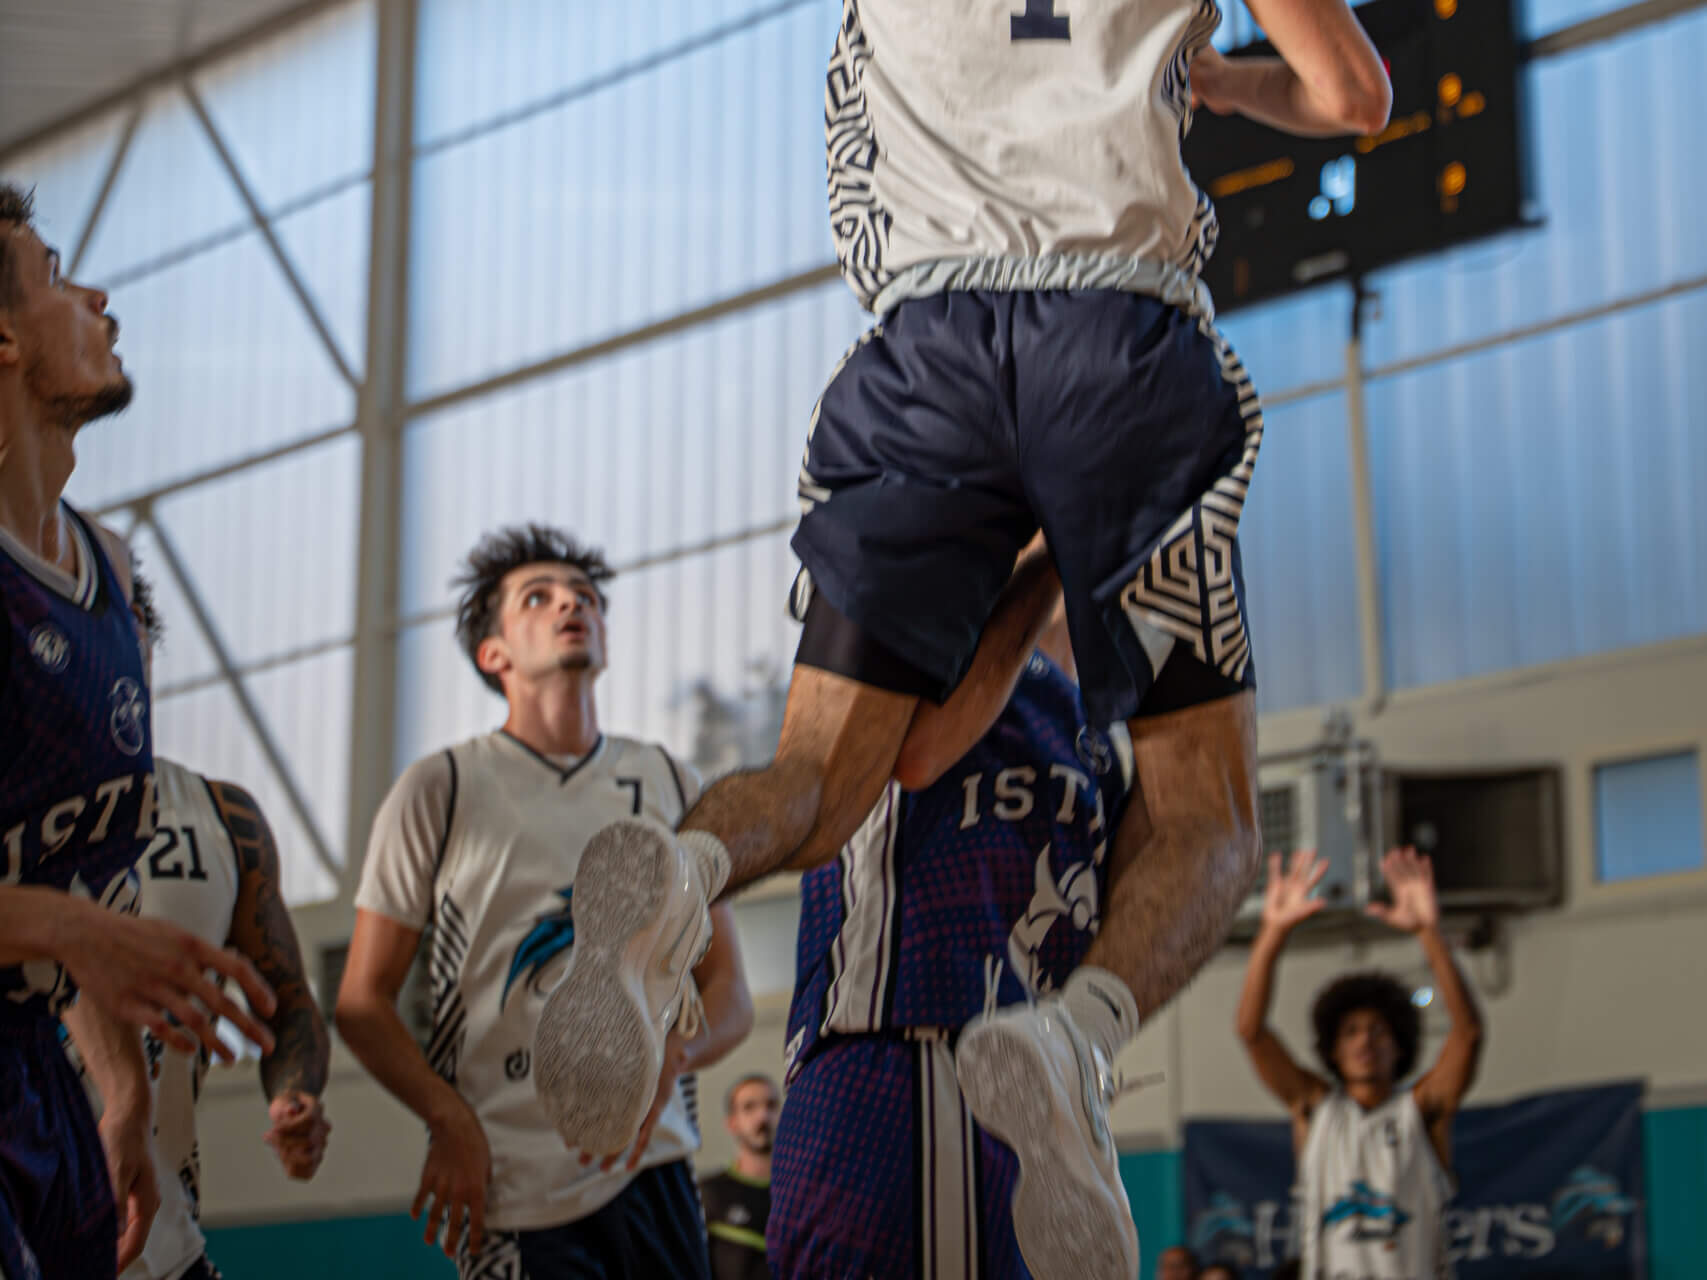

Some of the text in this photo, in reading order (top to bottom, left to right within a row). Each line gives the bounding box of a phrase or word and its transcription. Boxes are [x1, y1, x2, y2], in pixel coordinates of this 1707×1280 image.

[616, 777, 643, 817] 7
[960, 763, 1105, 831] IST
[149, 825, 207, 880] 21
